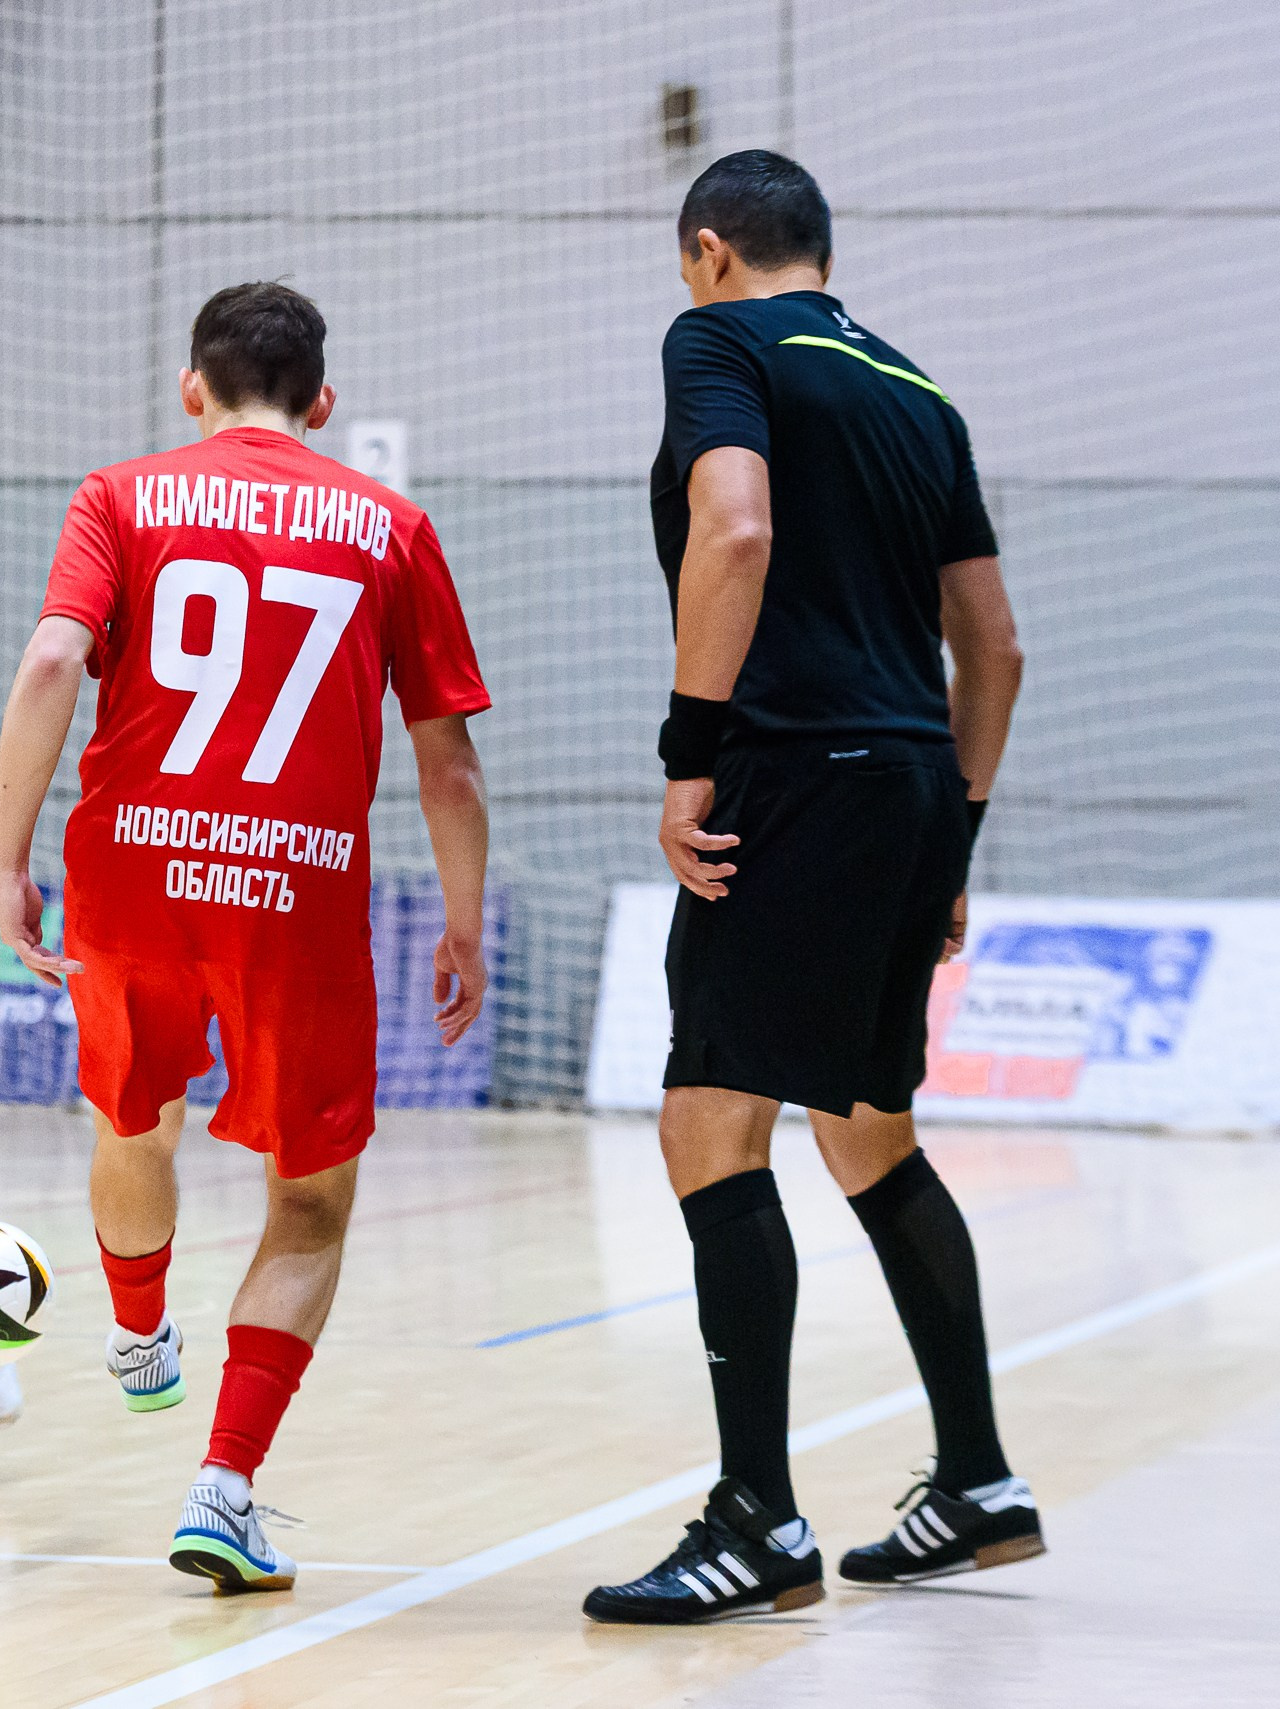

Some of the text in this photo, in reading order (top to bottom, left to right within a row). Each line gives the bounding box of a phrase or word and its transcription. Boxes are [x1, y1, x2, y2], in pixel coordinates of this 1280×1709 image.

[150, 558, 365, 784] 97
[114, 803, 356, 872] НОВОСИБИРСКАЯ
[166, 859, 296, 913] ОБЛАСТЬ
